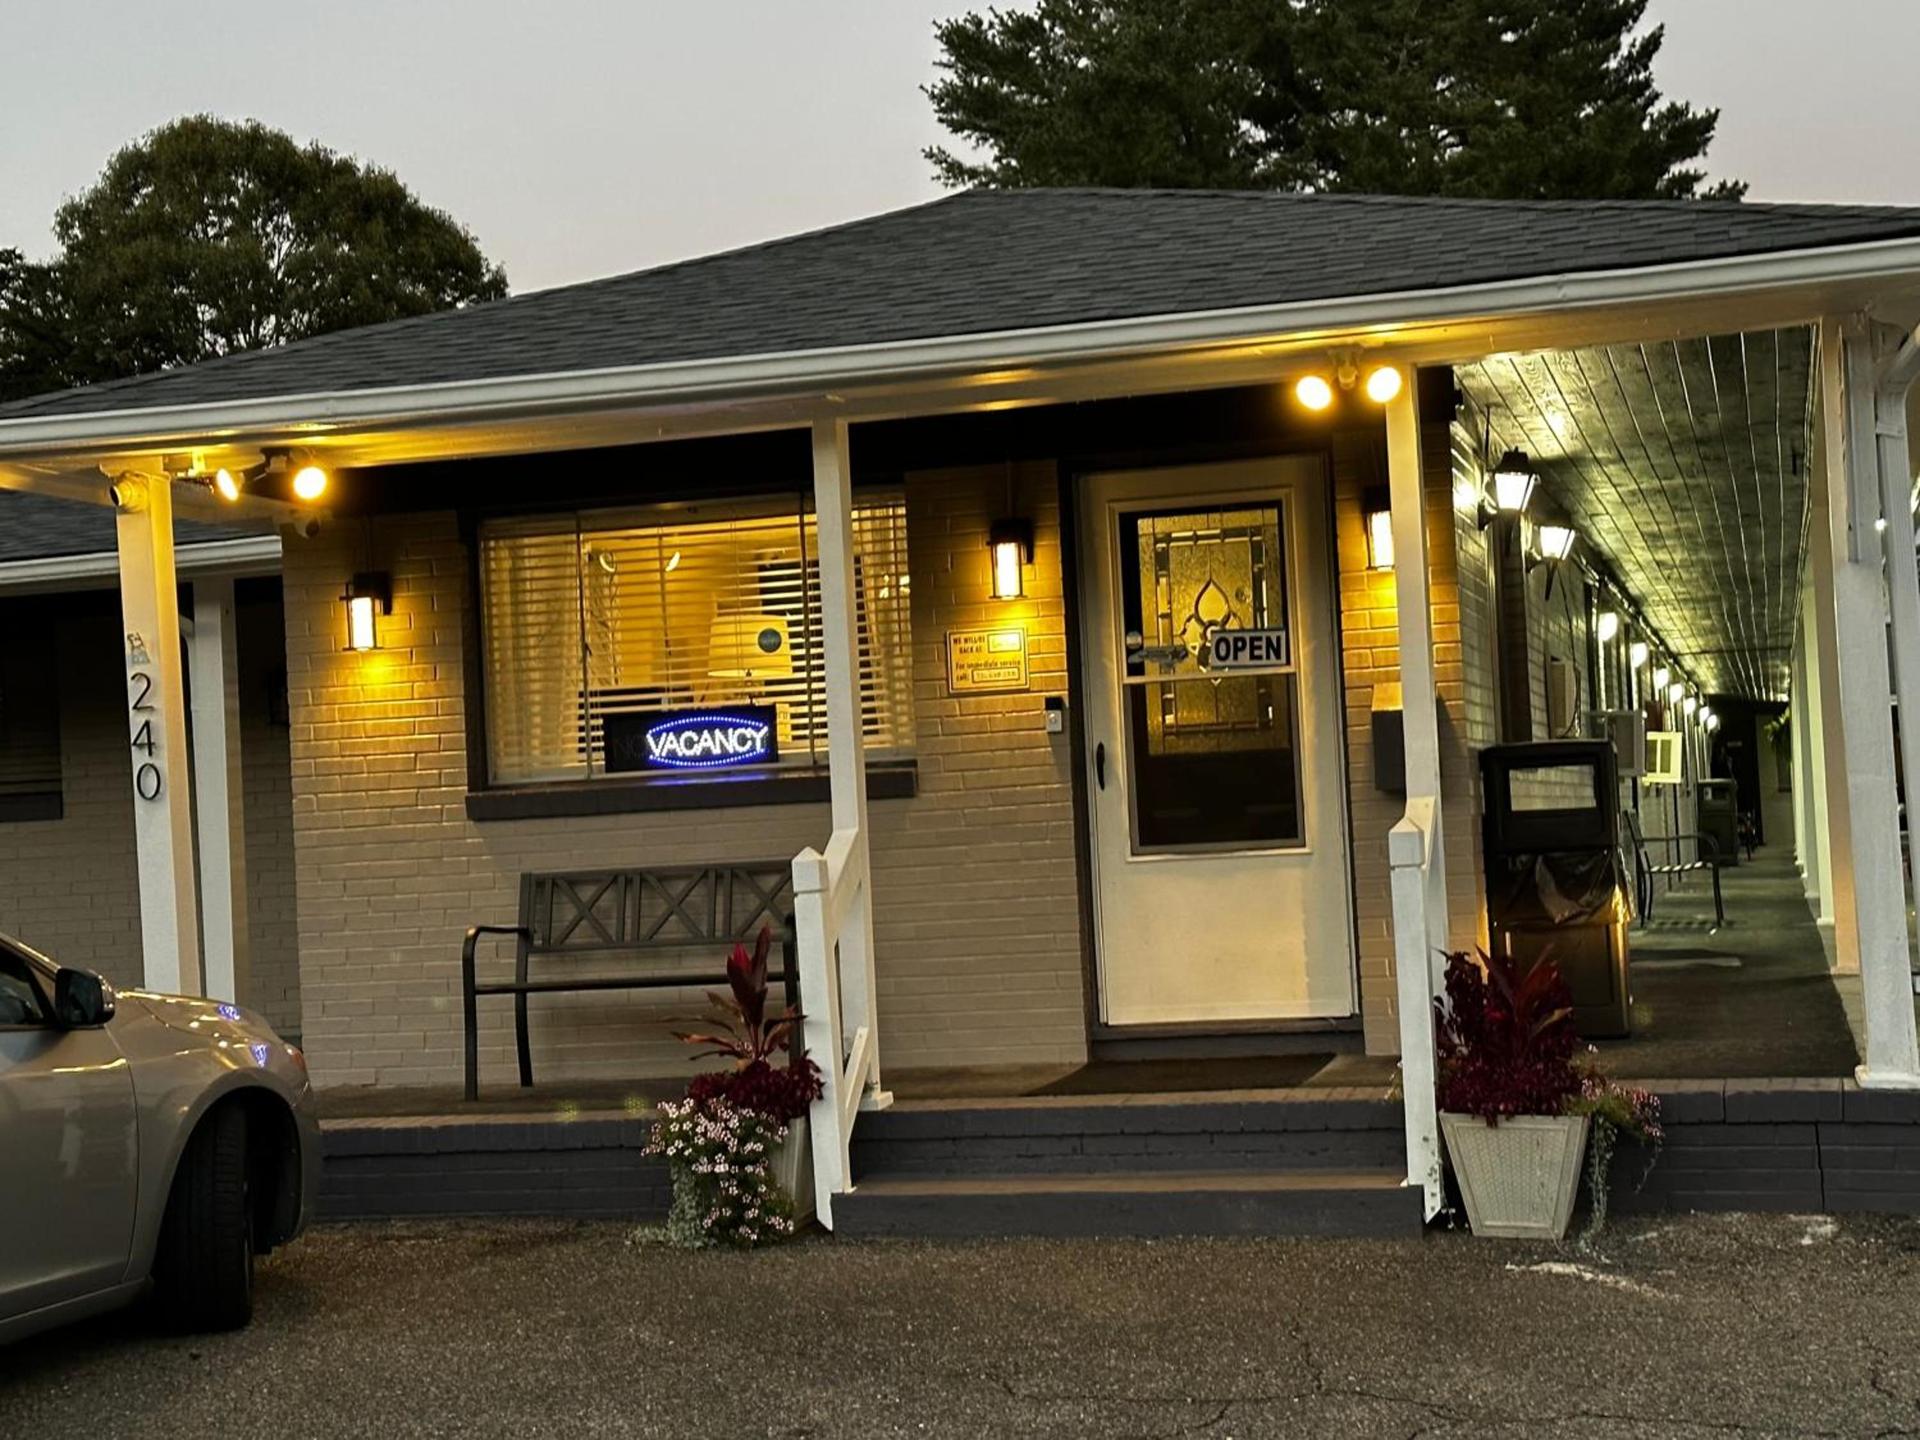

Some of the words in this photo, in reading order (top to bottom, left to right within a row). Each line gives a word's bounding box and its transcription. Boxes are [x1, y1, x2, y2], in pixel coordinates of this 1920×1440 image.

[1214, 635, 1282, 661] OPEN
[130, 671, 162, 801] 240
[646, 726, 769, 757] VACANCY
